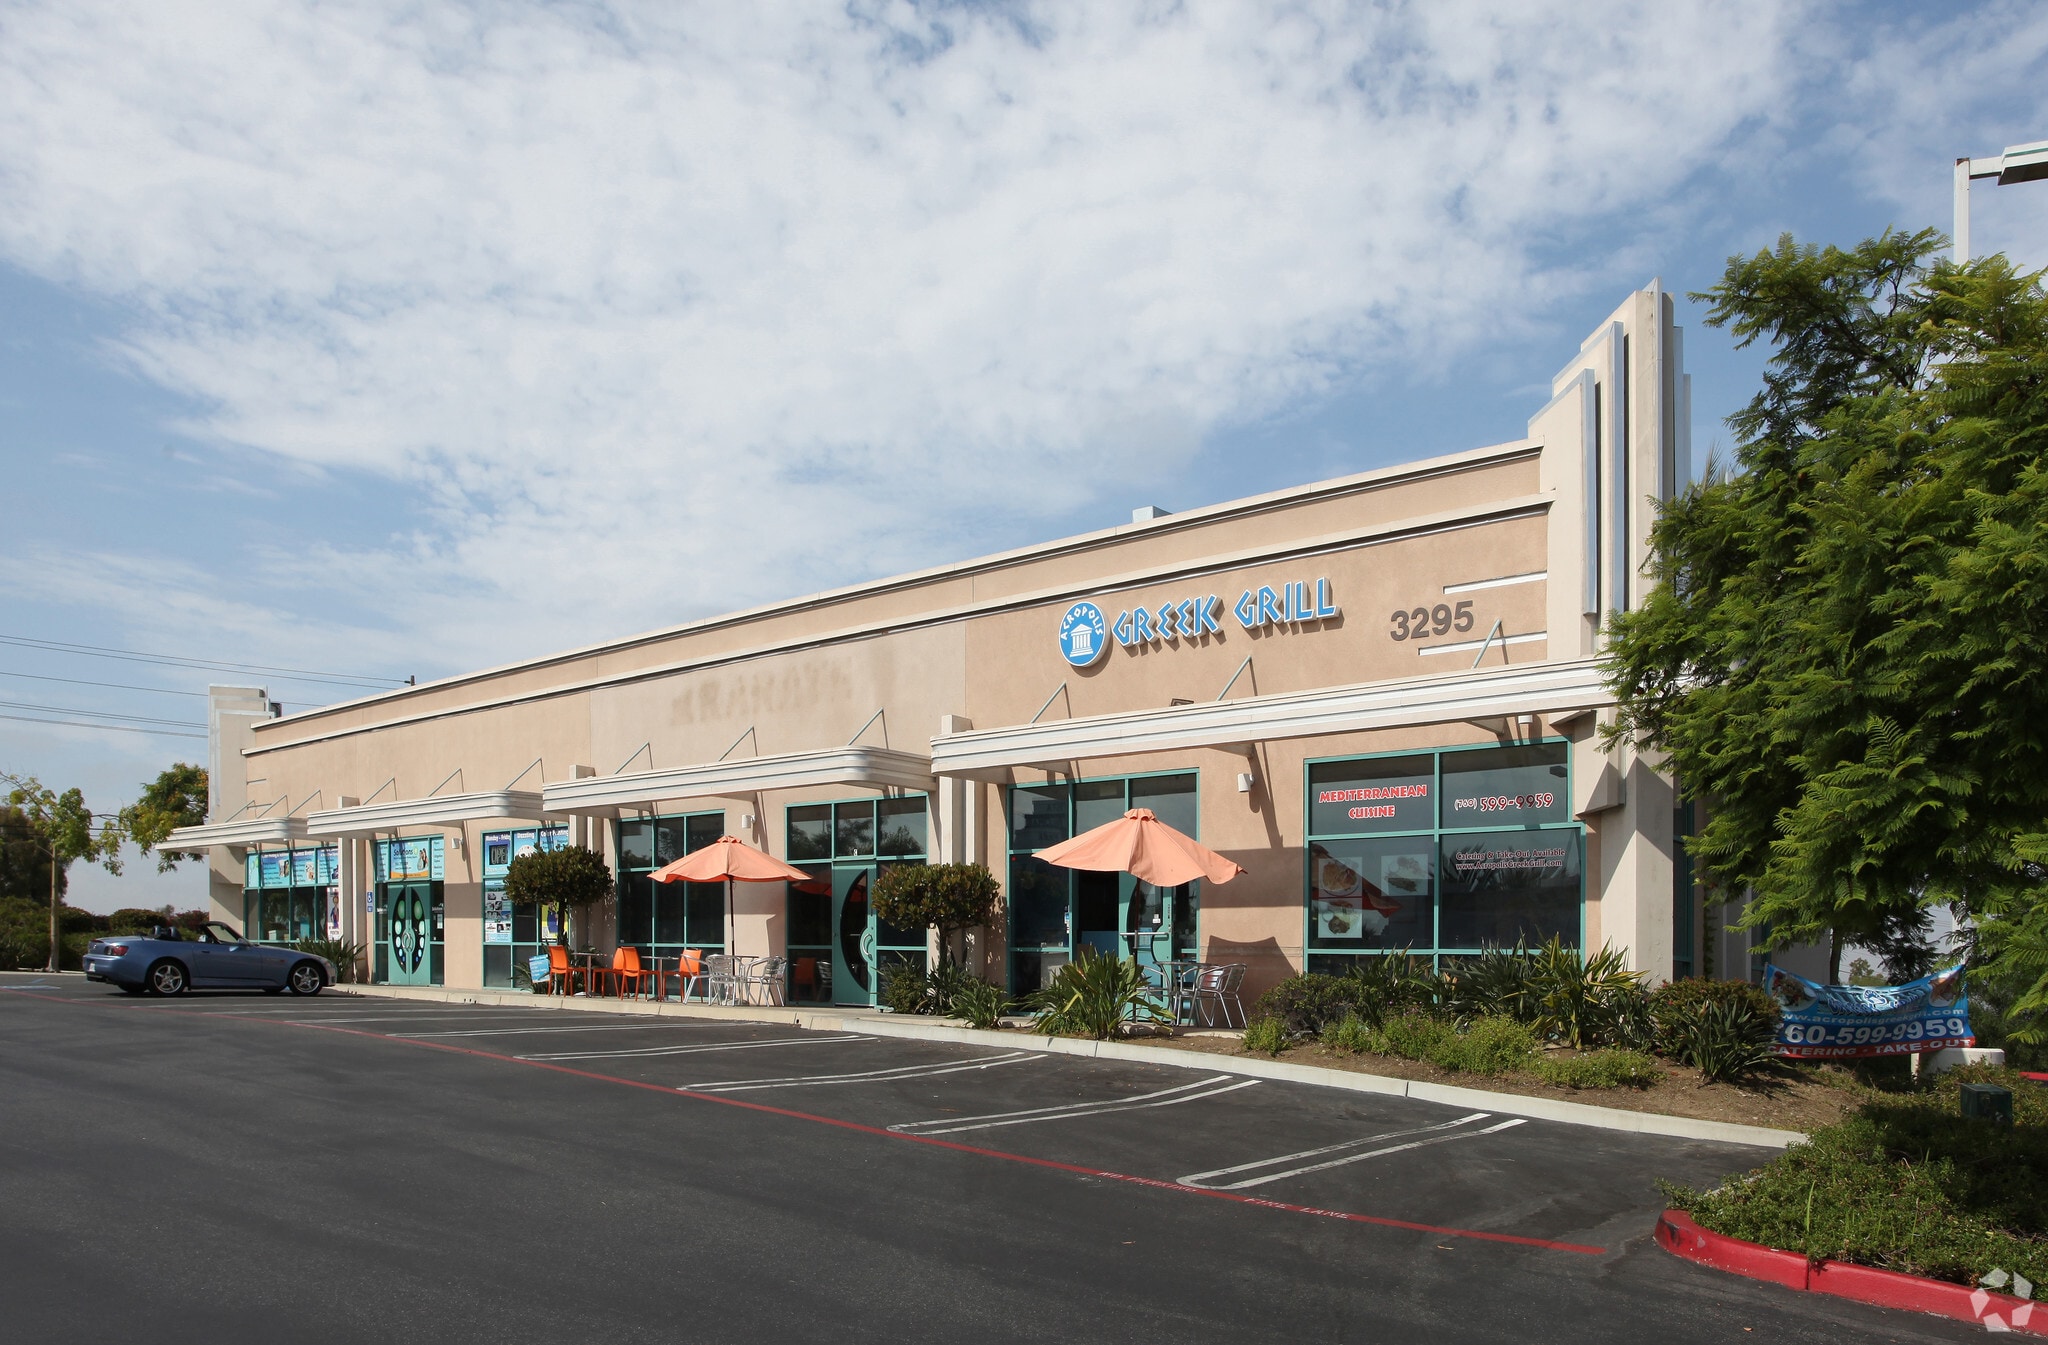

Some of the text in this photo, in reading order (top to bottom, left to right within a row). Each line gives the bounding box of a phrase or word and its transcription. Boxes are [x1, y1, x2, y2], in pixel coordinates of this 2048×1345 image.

[1112, 577, 1337, 647] GREEK GRILL
[1390, 600, 1474, 641] 3295
[1061, 606, 1103, 640] ACROPOLIS
[1318, 784, 1428, 804] MEDITERRANEAN
[1480, 792, 1554, 811] 599-9959
[1348, 805, 1396, 820] CUISINE
[1456, 847, 1566, 861] Catering & Take-Out Available
[1456, 858, 1563, 871] www.AcropolisGreekGrill.com
[1780, 1009, 1964, 1025] ww.acropolisgreekgrill.com
[1776, 1018, 1964, 1046] 60-599-9959
[1768, 1039, 1971, 1056] CATERING TAKE-OUT
